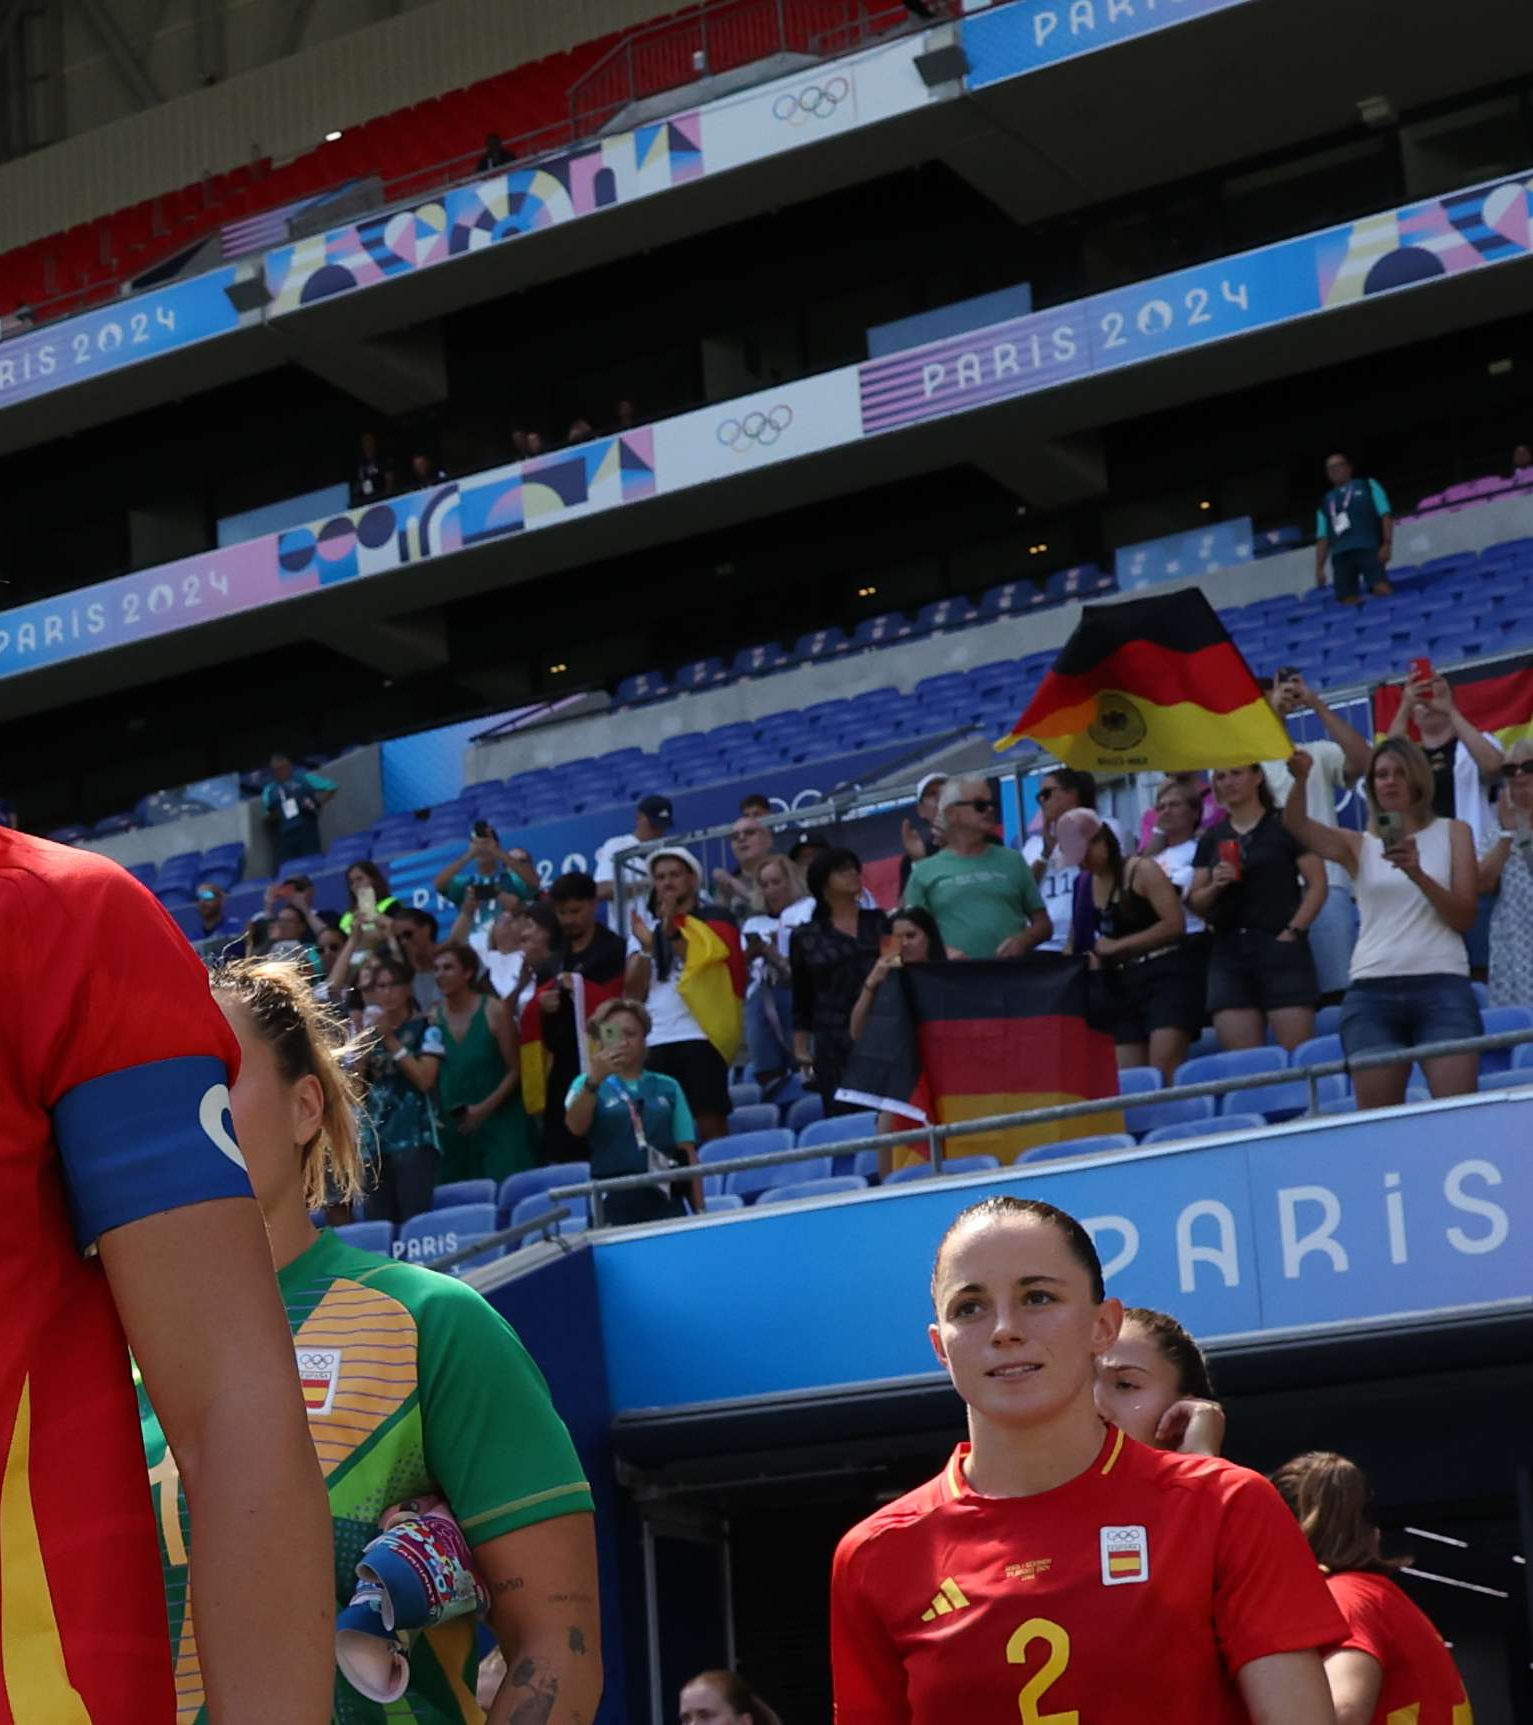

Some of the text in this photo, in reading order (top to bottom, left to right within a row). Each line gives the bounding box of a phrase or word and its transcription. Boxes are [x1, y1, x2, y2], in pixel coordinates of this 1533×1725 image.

[73, 307, 174, 364] 2024
[1101, 281, 1248, 348] 2024
[122, 572, 228, 625] 2024
[1006, 1617, 1079, 1725] 2
